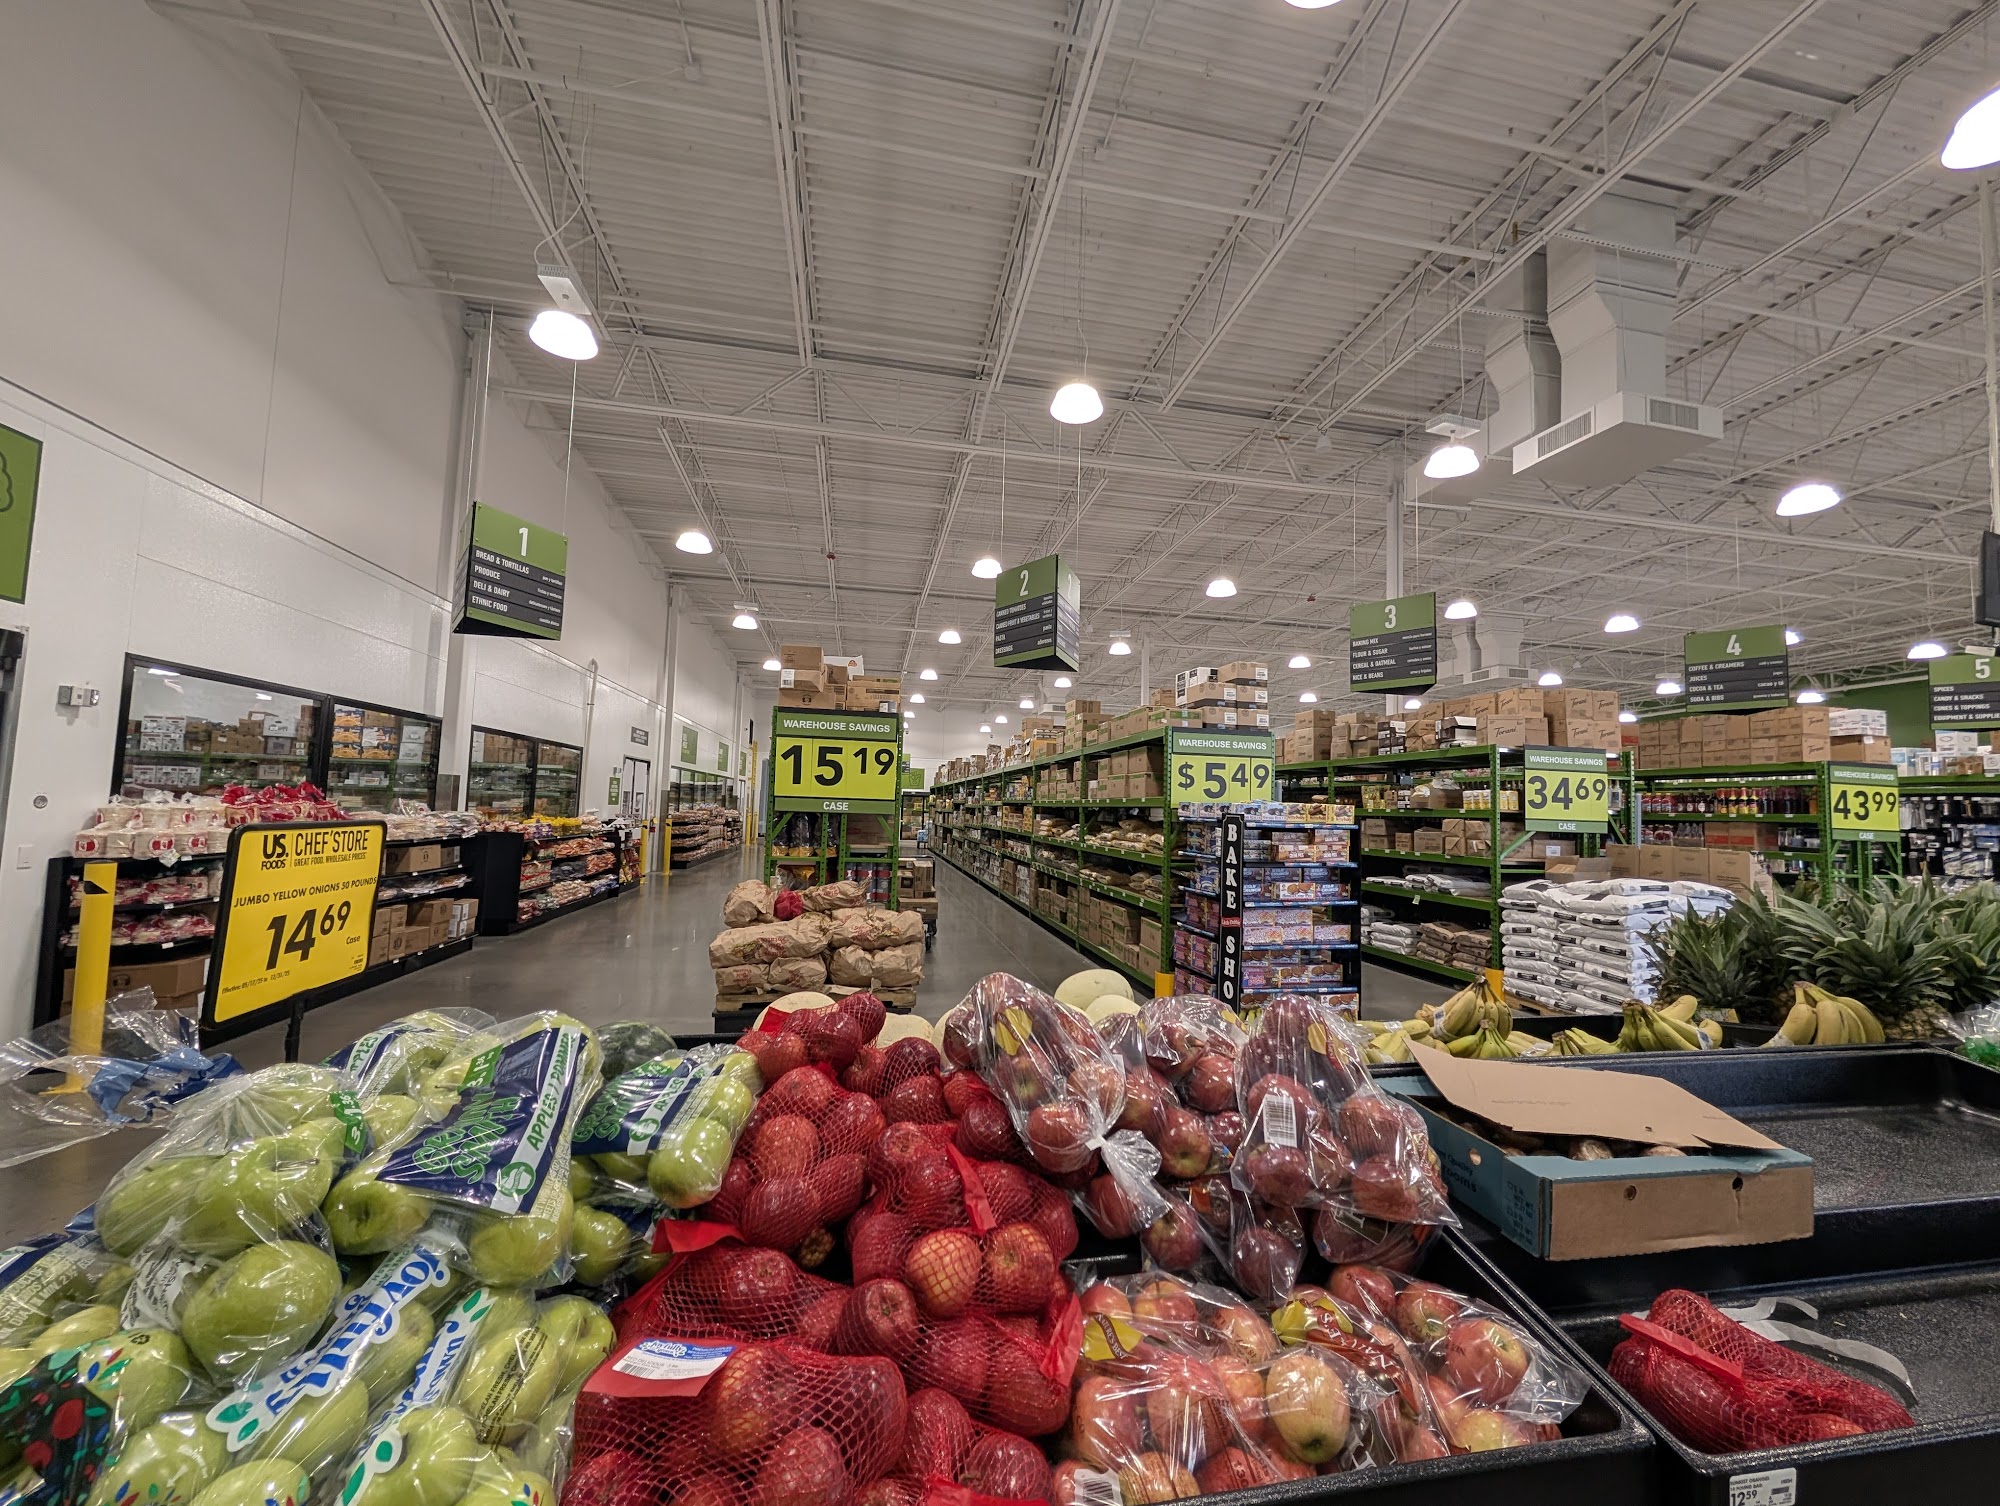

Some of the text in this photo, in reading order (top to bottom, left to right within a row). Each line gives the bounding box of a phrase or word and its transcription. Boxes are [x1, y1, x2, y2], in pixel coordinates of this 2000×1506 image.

[519, 527, 528, 557] 1
[476, 550, 530, 574] BREAD & TORTILLAS
[474, 565, 500, 580] PRODUCE
[474, 580, 510, 598] DELI & DAIRY
[1020, 570, 1028, 597] 2
[472, 596, 508, 612] ETHNIC FOOD
[1020, 612, 1040, 623] VEGETABLES
[1384, 605, 1396, 629] 3
[996, 634, 1005, 642] PASTA
[1353, 639, 1369, 647] BAKING
[1726, 635, 1742, 655] 4
[995, 645, 1013, 655] DRESSINGS
[1353, 662, 1369, 670] CEREAL
[1689, 664, 1708, 672] COFFEE
[1975, 659, 1990, 679] 5
[784, 719, 890, 732] WAREHOUSE SAVINGS
[1494, 726, 1517, 737] Torani
[1178, 738, 1267, 750] WAREHOUSE SAVINGS
[1530, 756, 1573, 764] WAREHOUSE
[1834, 771, 1870, 779] WAREHOUSE
[823, 802, 849, 810] CASE
[295, 830, 370, 856] CHEF'STORE
[261, 860, 286, 870] FOODS
[294, 858, 310, 867] GREAT
[311, 856, 324, 865] FOOD.
[326, 853, 351, 863] WHOLESALE
[1226, 824, 1238, 909] BAKE
[234, 876, 377, 908] JUMBO YELLOW ONIONS 50 POUNDS
[346, 935, 361, 945] Case
[1223, 935, 1235, 999] SHO
[526, 1094, 558, 1151] APPLES
[451, 1097, 522, 1184] SMITH
[266, 1244, 445, 1417] joyfully
